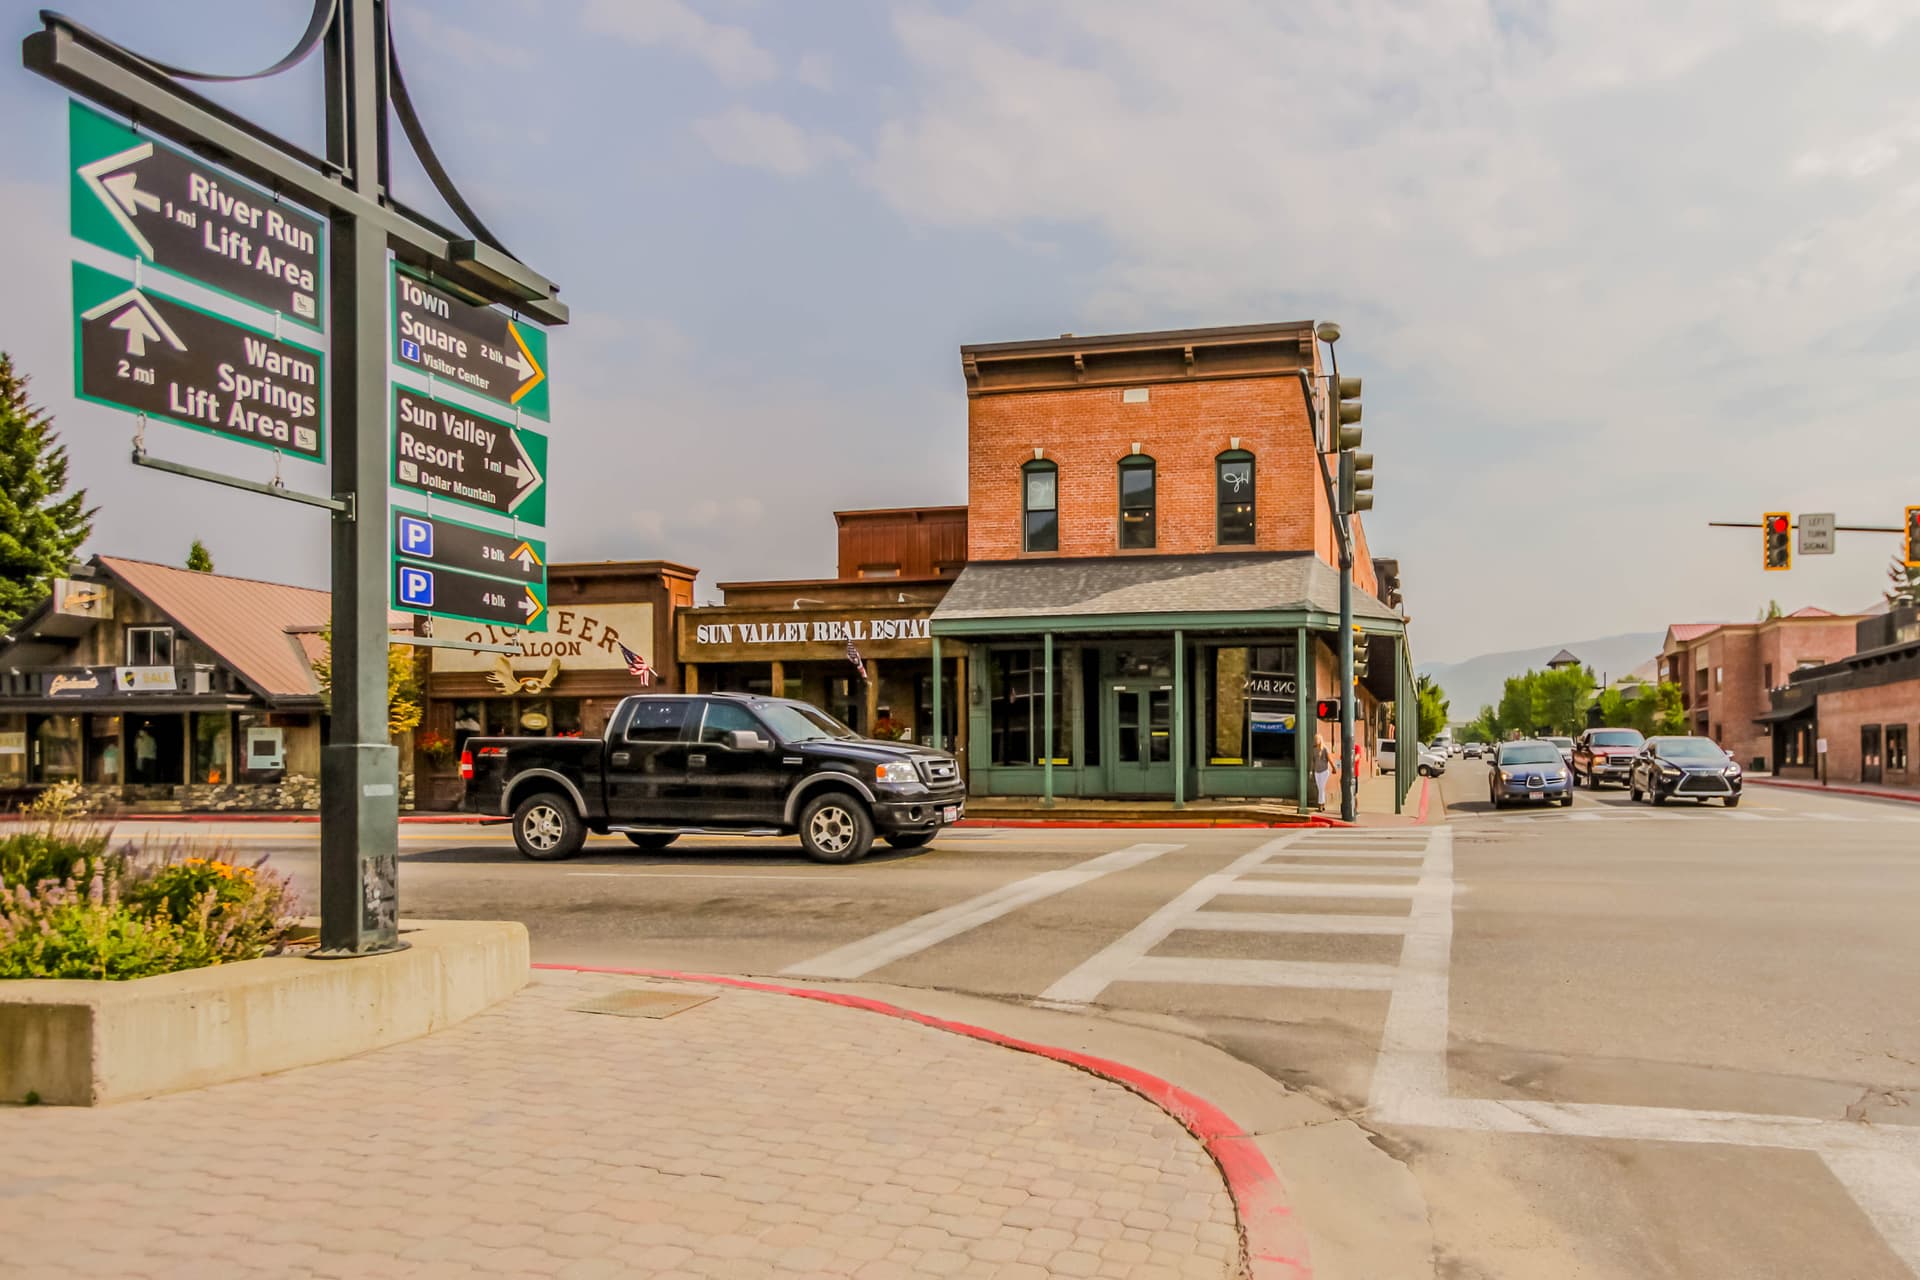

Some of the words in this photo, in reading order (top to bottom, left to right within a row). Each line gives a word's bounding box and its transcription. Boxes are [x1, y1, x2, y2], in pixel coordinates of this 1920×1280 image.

[165, 202, 173, 218] 1
[176, 207, 197, 229] mi
[189, 173, 262, 229] River
[266, 210, 315, 255] Run
[204, 221, 252, 266] Lift
[256, 246, 315, 292] Area
[400, 276, 449, 319] Town
[401, 311, 467, 359] Square
[244, 337, 315, 386] Warm
[423, 352, 456, 376] Visitor
[457, 366, 490, 390] Center
[480, 344, 487, 358] 2
[489, 347, 504, 365] blk
[117, 359, 130, 378] 2
[134, 366, 155, 385] mi
[218, 363, 316, 418] Springs
[170, 382, 220, 423] Lift
[228, 403, 289, 442] Area
[400, 398, 437, 431] Sun
[442, 411, 496, 454] Valley
[400, 432, 465, 473] Resort
[484, 457, 489, 470] 1
[490, 461, 503, 474] mi
[421, 471, 452, 492] Dollar
[453, 482, 496, 504] Mountain
[408, 524, 426, 549] P
[1808, 518, 1824, 527] LEFT
[1808, 530, 1827, 538] TURN
[482, 546, 489, 558] 3
[490, 548, 505, 562] blk
[409, 575, 427, 599] P
[482, 592, 490, 604] 4
[491, 594, 506, 608] blk
[465, 611, 619, 656] PIOEER
[697, 624, 734, 644] SUN
[737, 622, 809, 643] VALLEY
[813, 620, 867, 641] REAL
[870, 618, 933, 640] ESTAT
